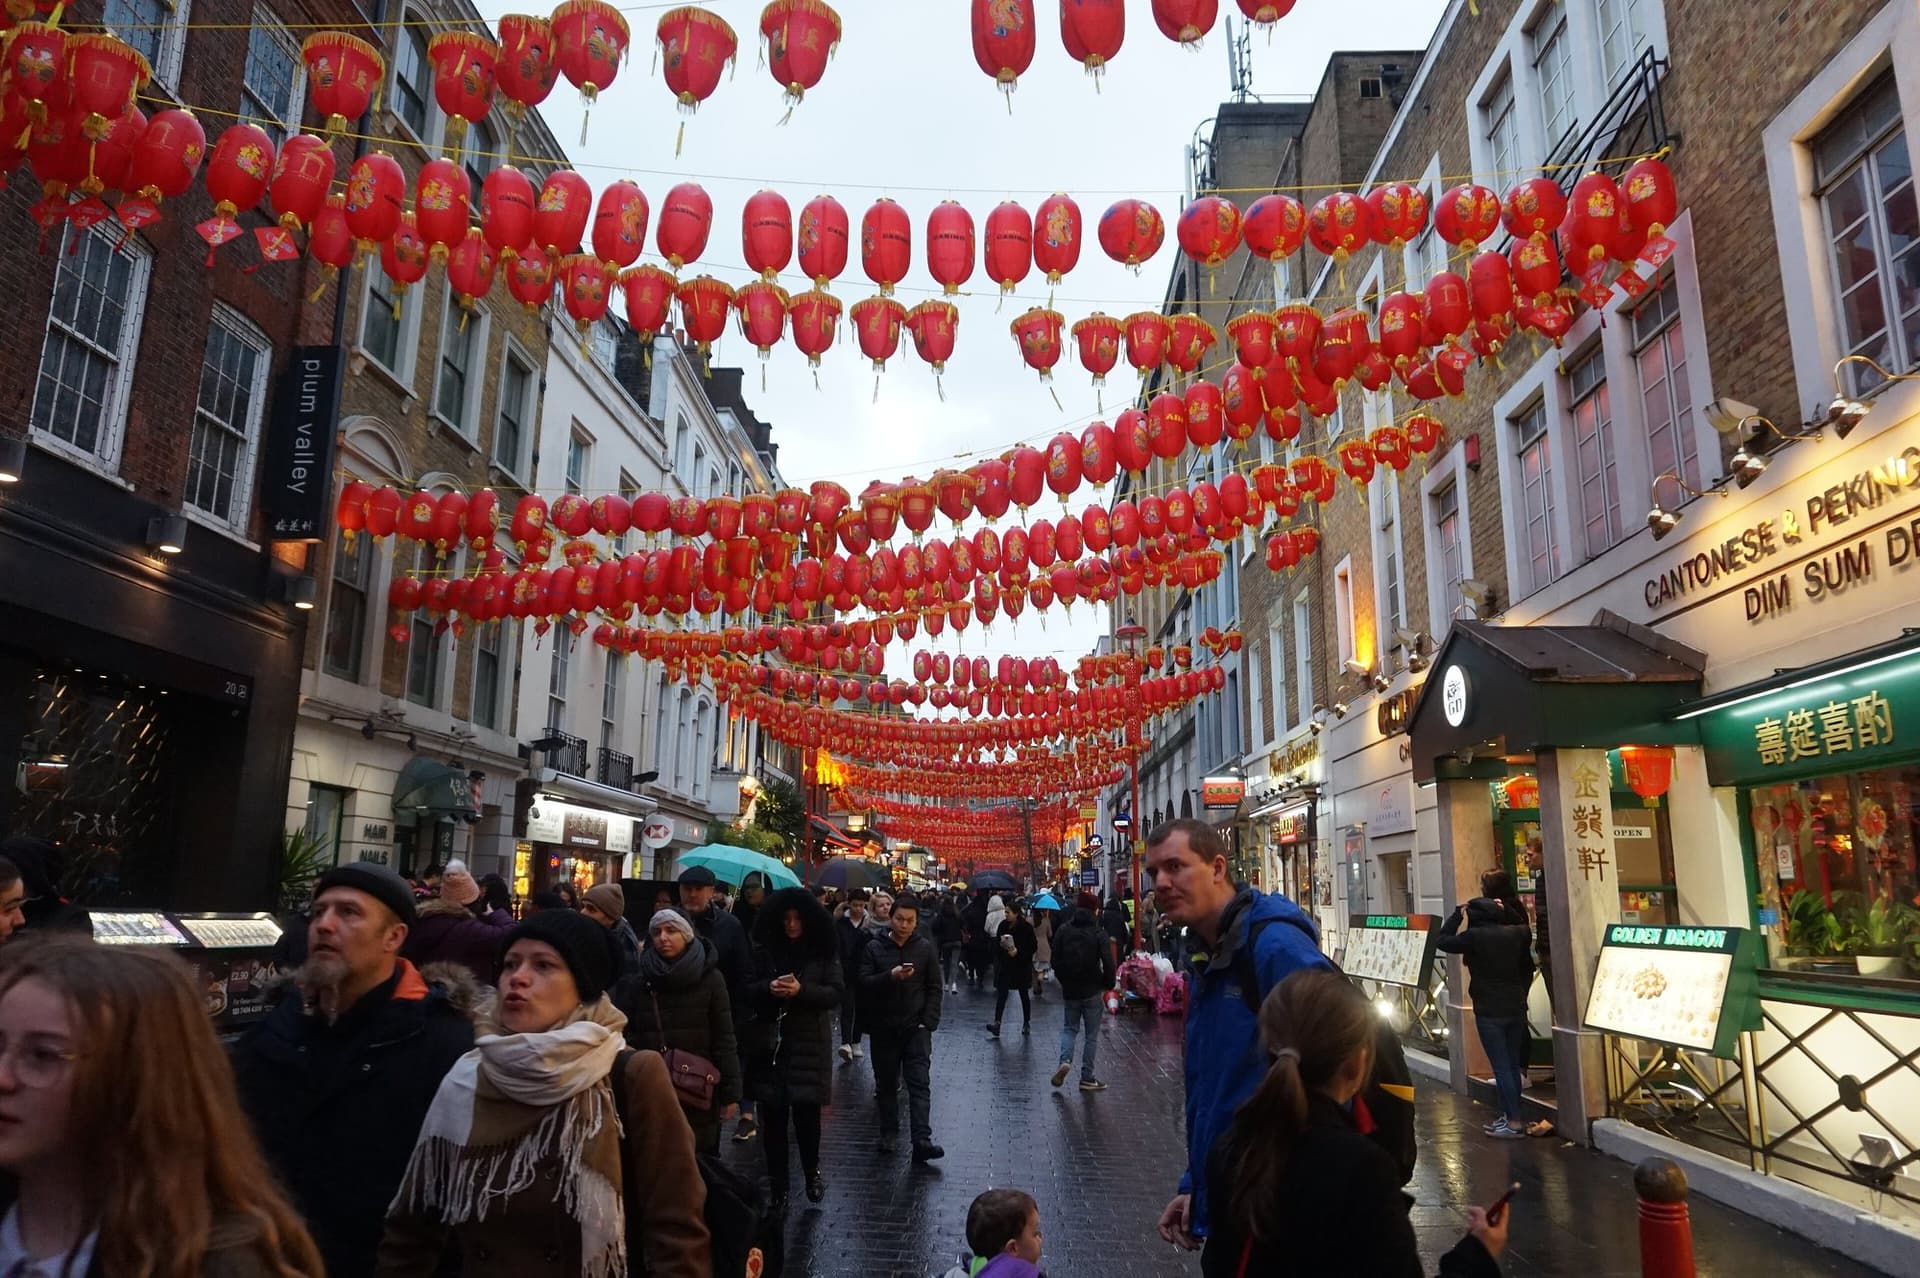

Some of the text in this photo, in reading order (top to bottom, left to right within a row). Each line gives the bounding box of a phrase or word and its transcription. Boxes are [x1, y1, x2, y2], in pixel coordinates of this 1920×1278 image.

[287, 359, 323, 494] plum valley
[1645, 446, 1920, 609] CANTONESE & PEKING
[1744, 574, 1791, 621] DIM
[1804, 540, 1872, 598] SUM
[1613, 829, 1643, 837] OPEN
[1611, 926, 1727, 949] GOLDEN DRAGON
